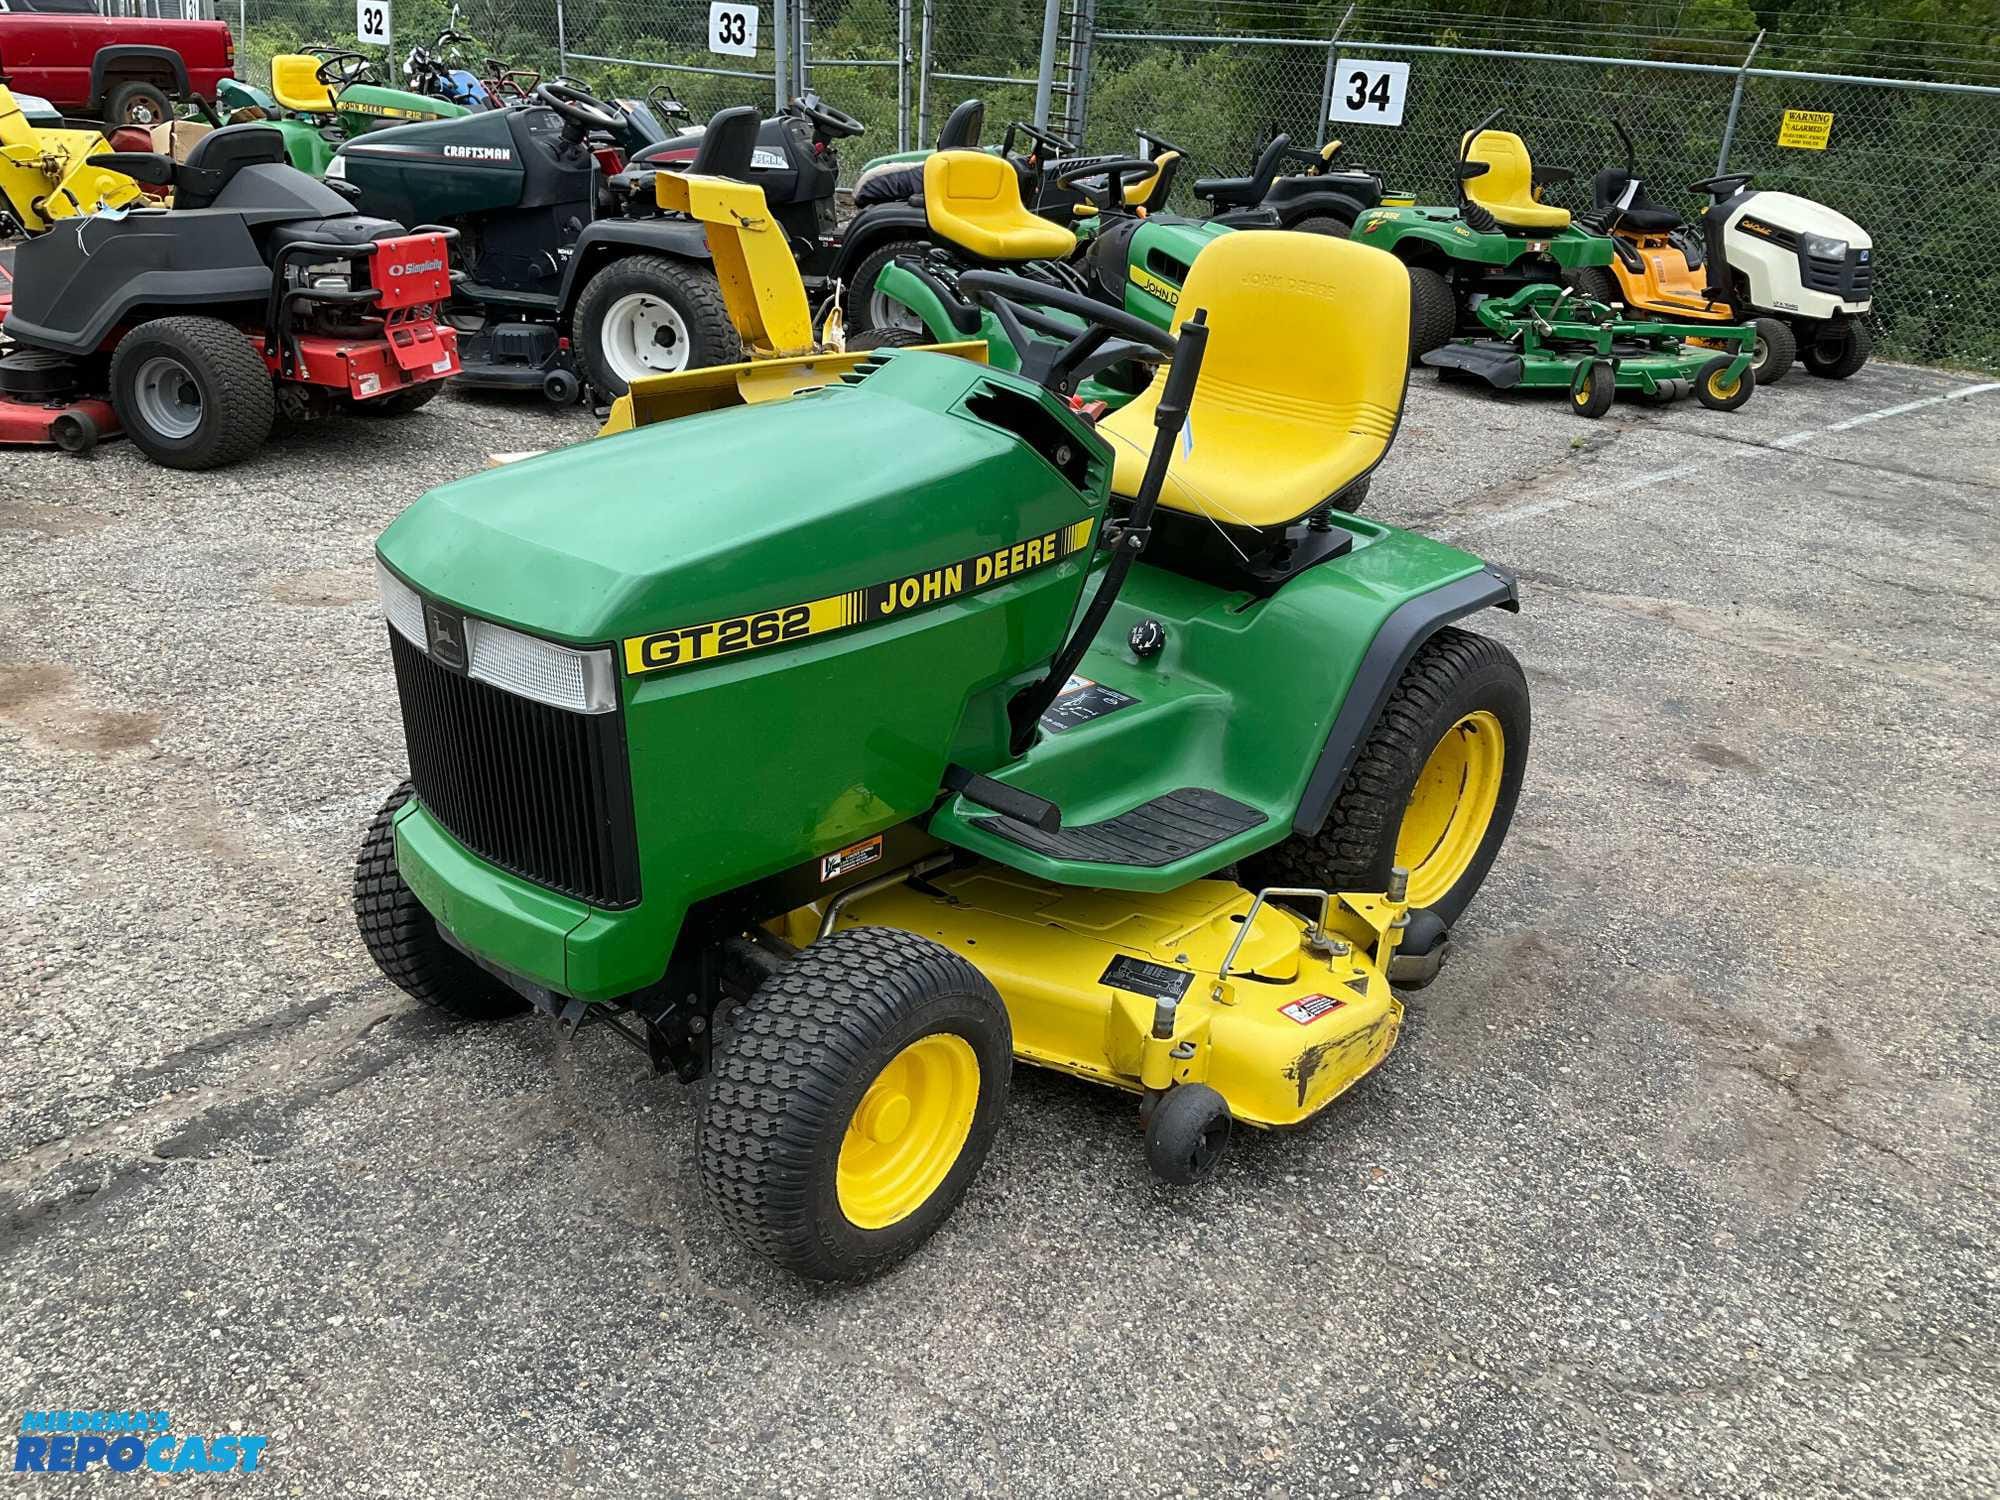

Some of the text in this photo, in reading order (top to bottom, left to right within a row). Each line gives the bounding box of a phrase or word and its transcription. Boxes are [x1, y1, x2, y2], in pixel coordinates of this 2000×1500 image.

[364, 8, 383, 35] 32
[719, 12, 746, 45] 33
[1346, 71, 1391, 112] 34
[1789, 112, 1830, 123] WARNING
[1791, 123, 1823, 132] ALARMED
[444, 145, 511, 160] CRAFTSMAN
[1144, 279, 1169, 301] JOHN
[1240, 272, 1337, 302] JOHN DEERE
[641, 533, 1056, 669] GT262 JOHN DEERE
